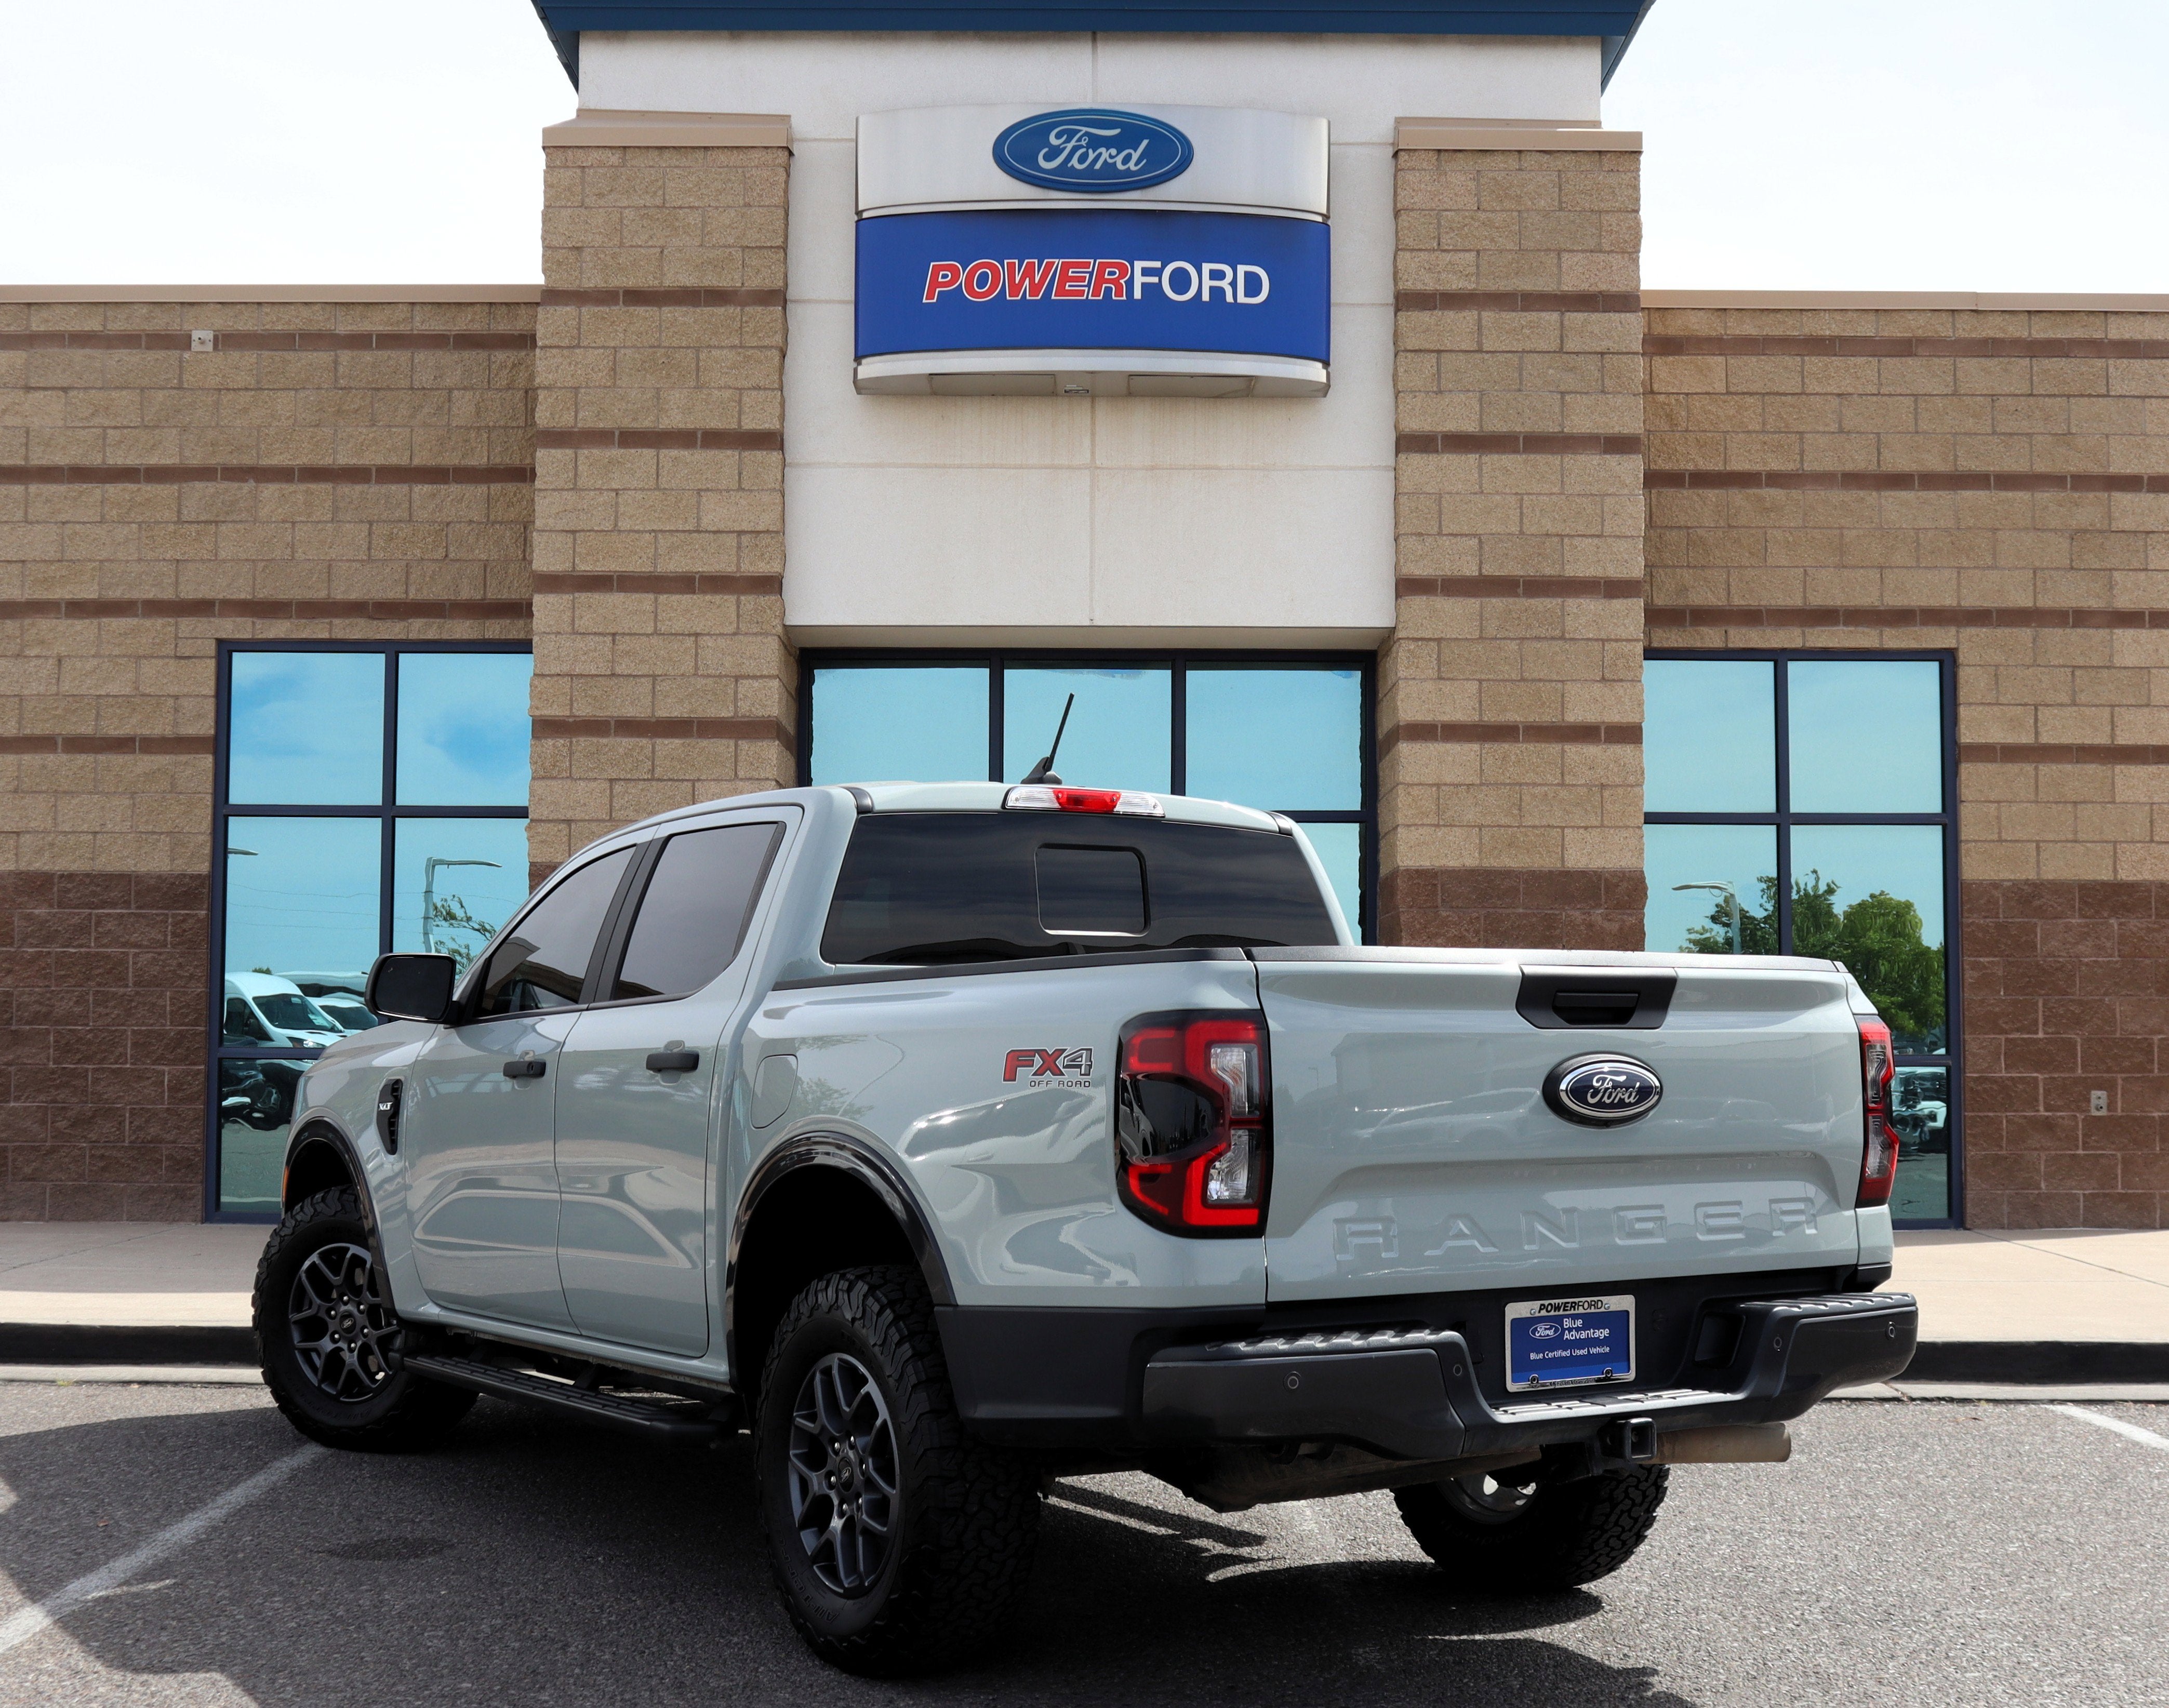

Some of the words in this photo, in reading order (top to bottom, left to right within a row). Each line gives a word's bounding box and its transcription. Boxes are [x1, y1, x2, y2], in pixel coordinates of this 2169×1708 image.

[1038, 127, 1148, 171] Ford
[922, 259, 1270, 304] POWERFORD
[1002, 1047, 1094, 1084] FX4
[1029, 1080, 1053, 1088] OFF
[1058, 1080, 1091, 1088] ROAD
[1587, 1074, 1640, 1104] Ford
[378, 1102, 393, 1111] XLT
[1333, 1196, 1819, 1261] RANGER
[1538, 1300, 1603, 1314] POWERFORD
[1563, 1318, 1583, 1328] Blue
[1535, 1325, 1555, 1337] Ford
[1563, 1328, 1609, 1341] Advantage
[1545, 1350, 1571, 1358] Certified
